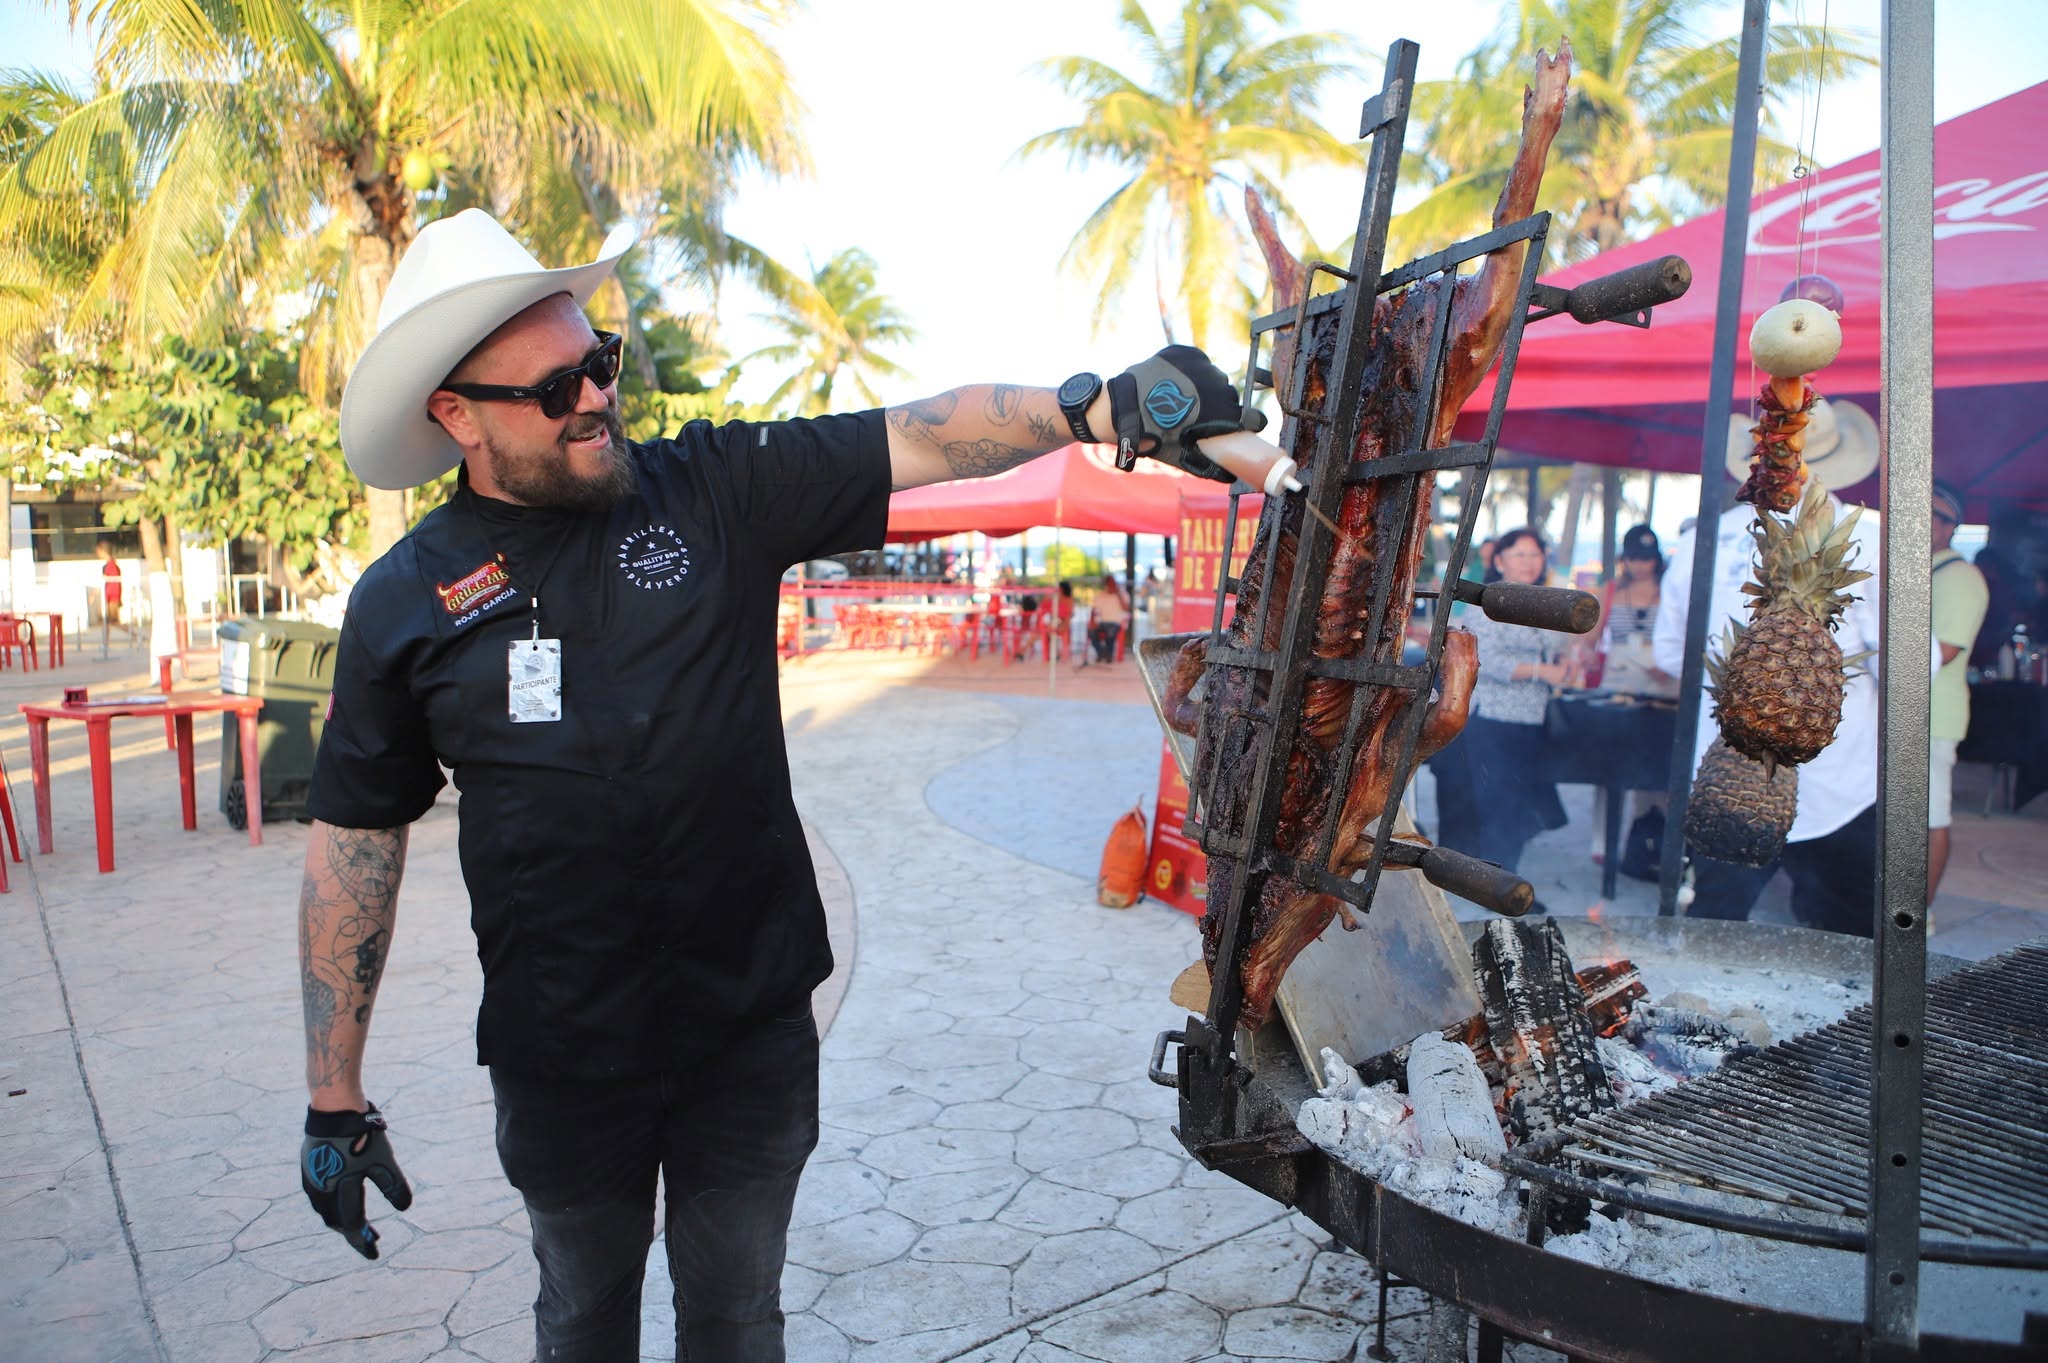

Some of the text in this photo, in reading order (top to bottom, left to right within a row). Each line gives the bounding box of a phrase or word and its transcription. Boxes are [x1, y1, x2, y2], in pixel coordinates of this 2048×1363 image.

[617, 525, 688, 569] PARRILLEROS
[632, 554, 663, 568] QUALITY
[664, 551, 680, 559] BBQ
[626, 559, 690, 590] PLAYEROS
[454, 609, 480, 627] ROJO
[482, 587, 518, 611] GARCIA
[512, 675, 558, 692] PARTICIPANTE
